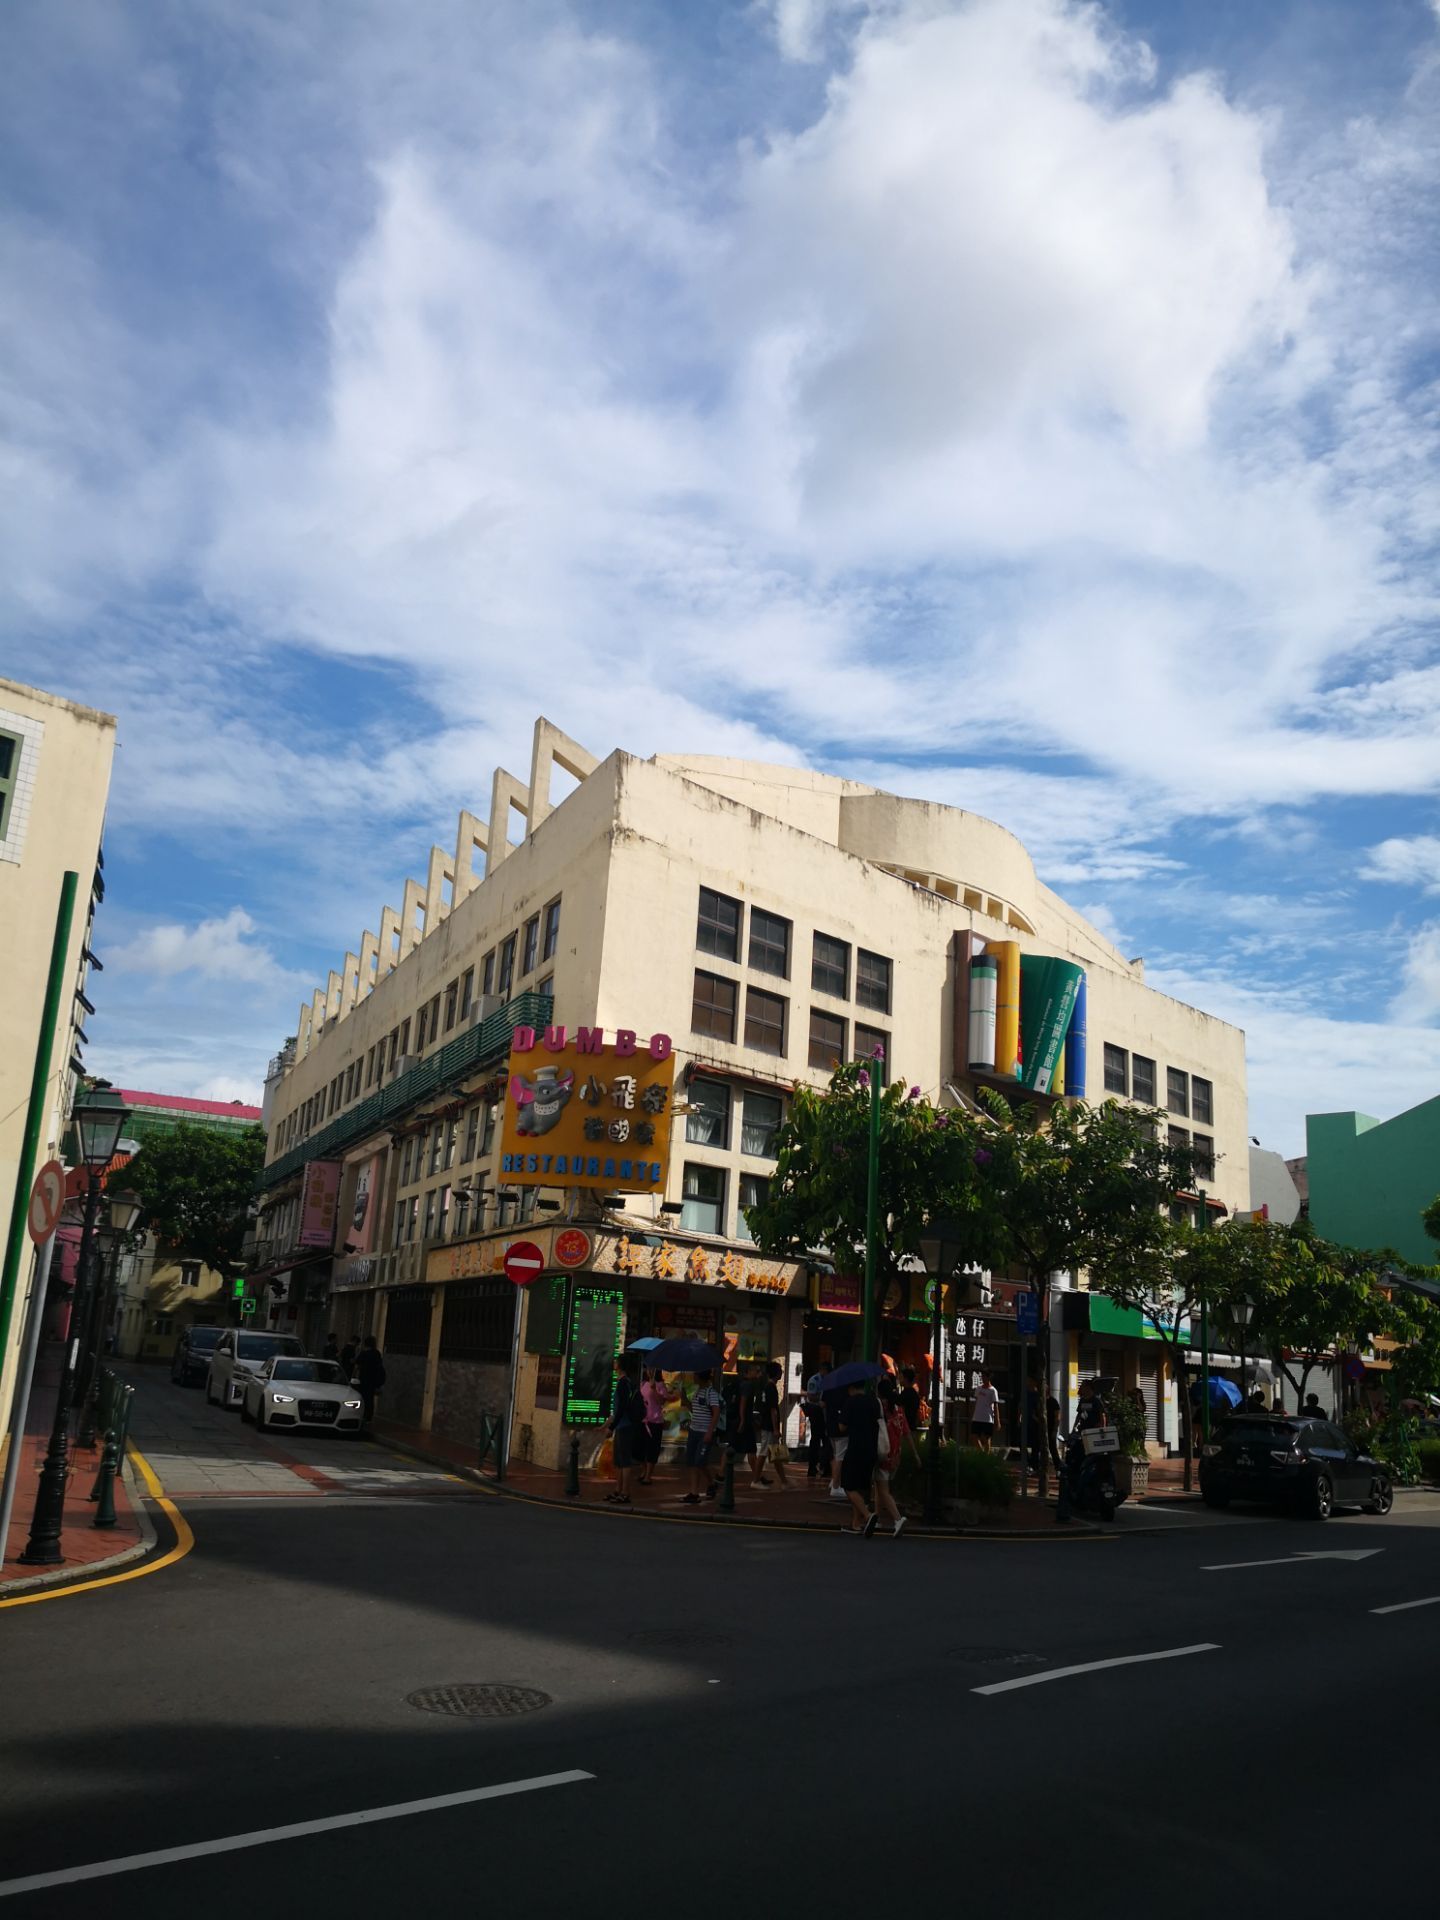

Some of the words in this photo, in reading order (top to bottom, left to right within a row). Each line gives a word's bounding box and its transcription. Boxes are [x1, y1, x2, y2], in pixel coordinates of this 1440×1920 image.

[512, 1025, 672, 1060] DUMBO
[579, 1075, 668, 1115] 小飛象
[502, 1153, 661, 1183] RESTAURANTE
[1018, 1292, 1027, 1315] P
